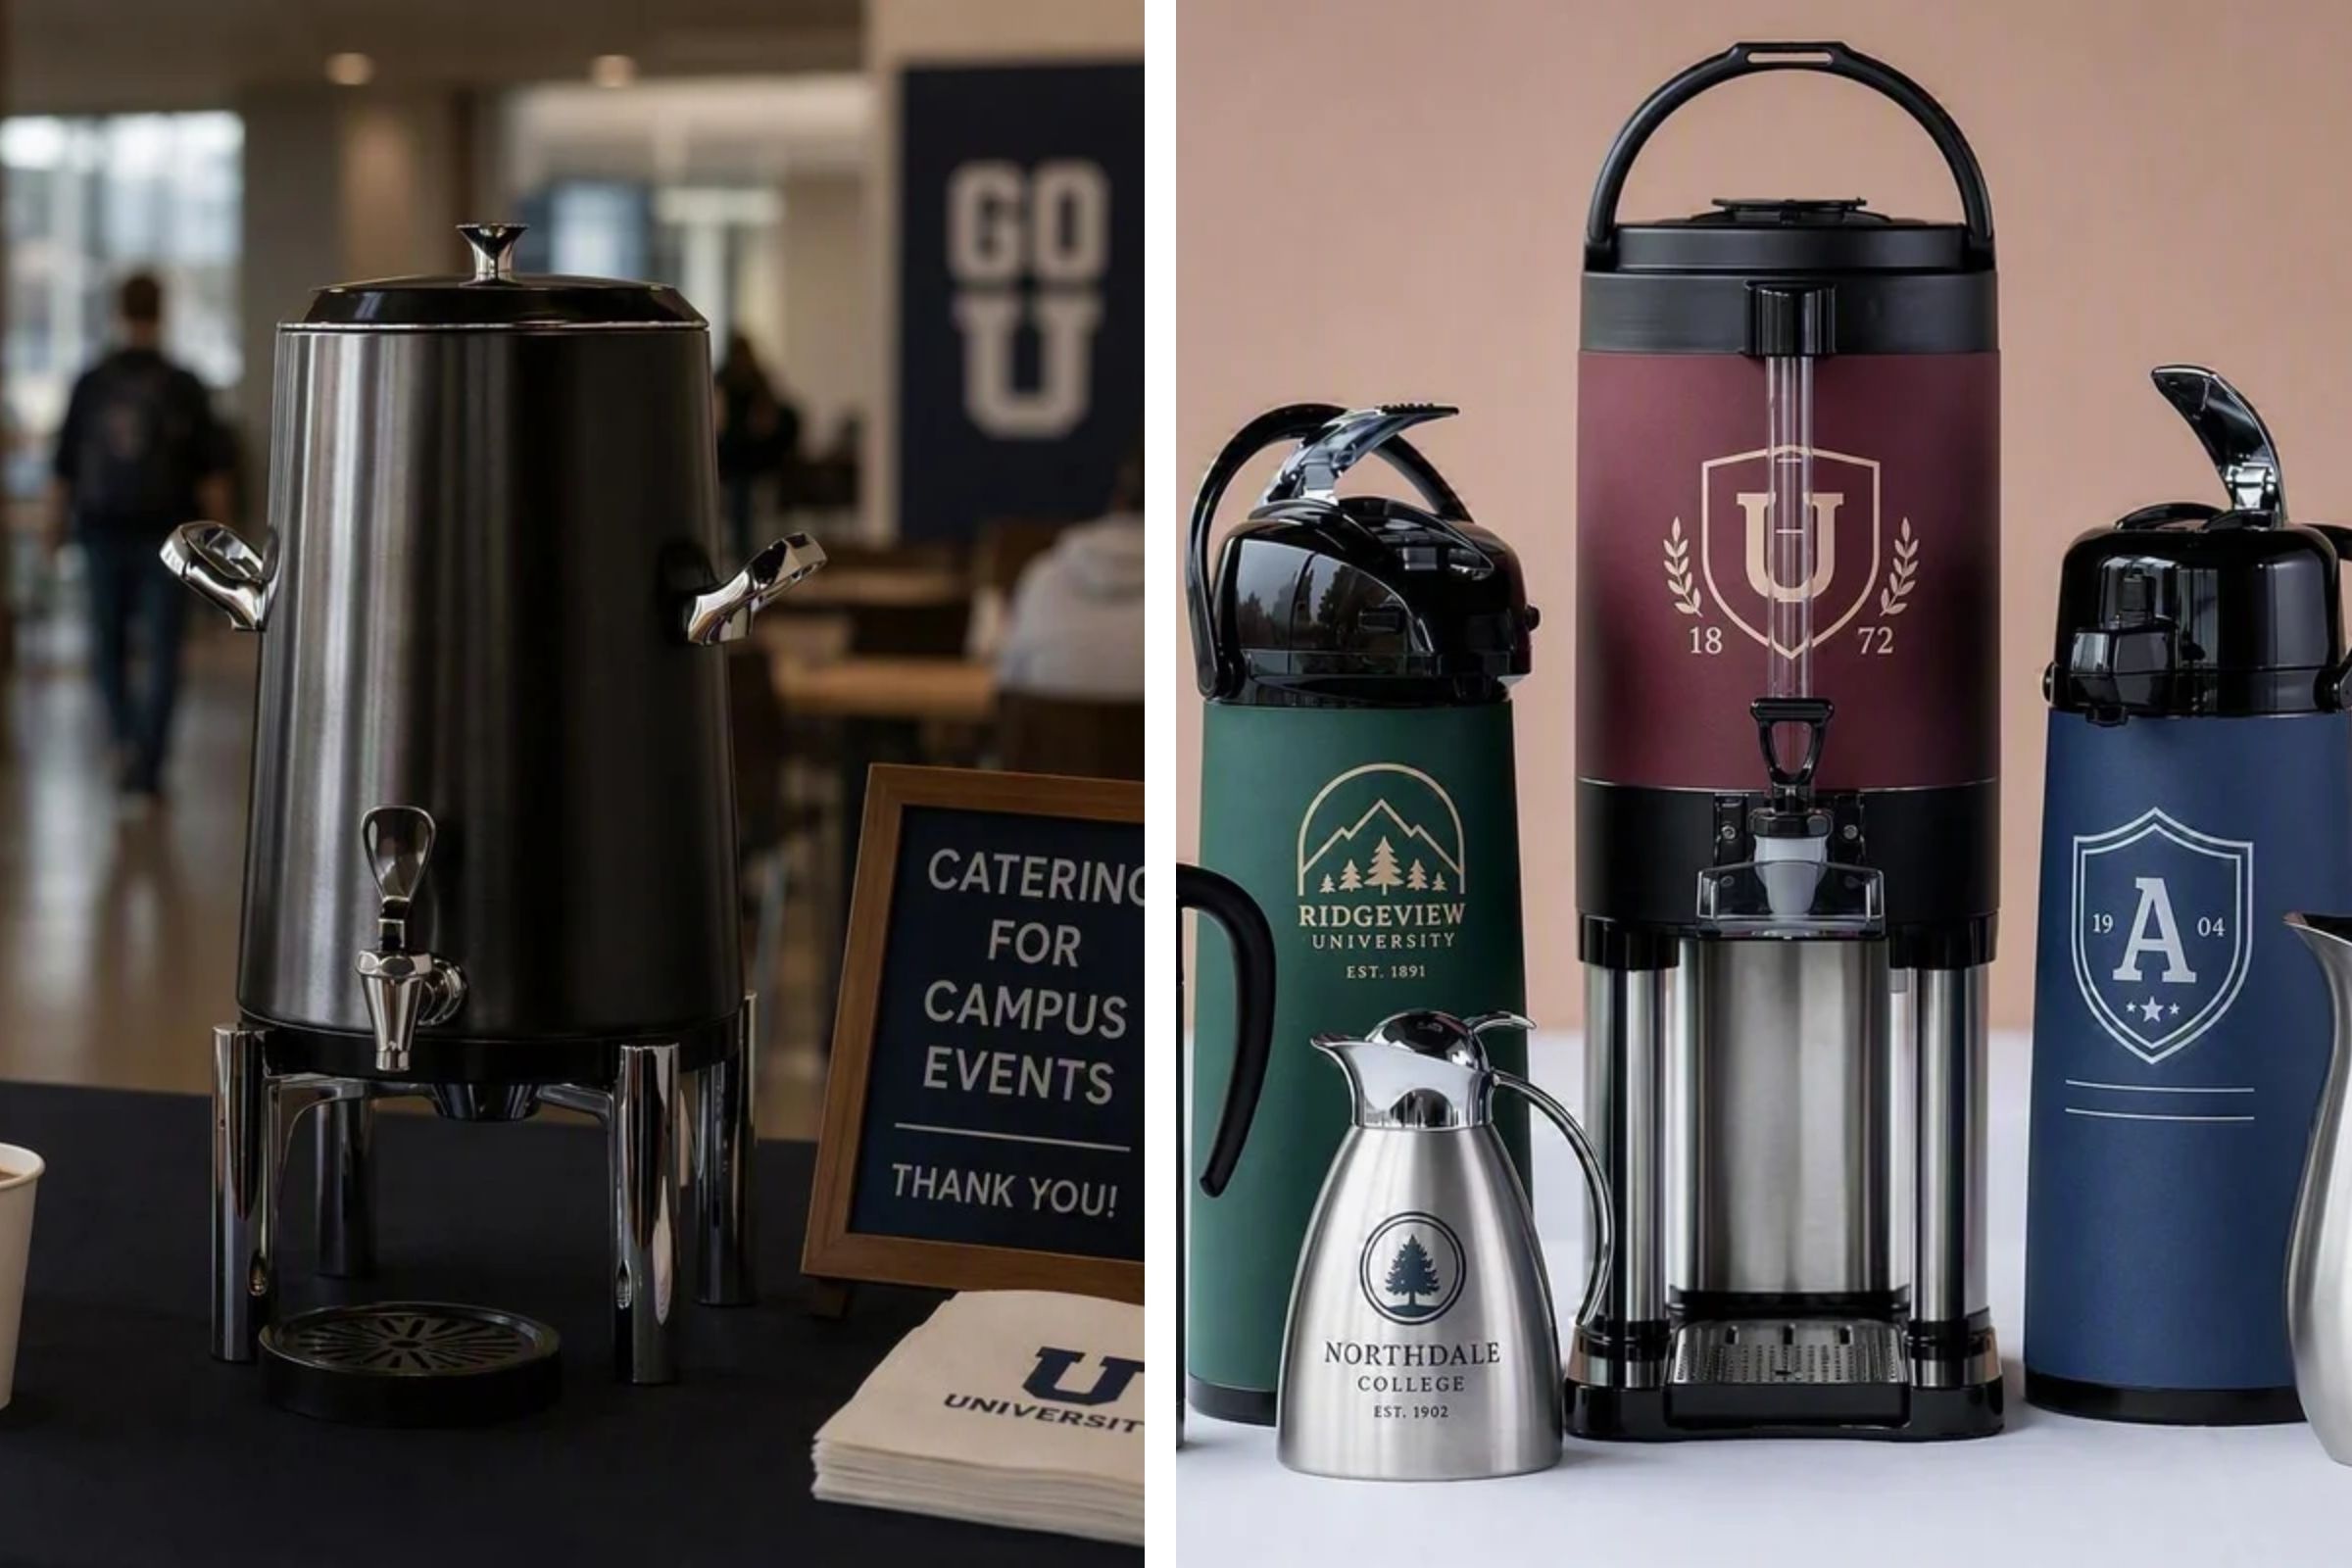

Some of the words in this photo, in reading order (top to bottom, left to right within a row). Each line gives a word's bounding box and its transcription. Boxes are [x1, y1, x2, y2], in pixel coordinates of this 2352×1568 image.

[947, 160, 1111, 280] GO
[953, 292, 1103, 438] U
[1737, 493, 1843, 602] U
[1690, 626, 1722, 654] 18
[1858, 626, 1893, 654] 72
[1298, 903, 1466, 928] RIDGEVIEW
[2092, 913, 2114, 934] 19
[2197, 916, 2226, 937] 04
[2113, 877, 2196, 983] A
[988, 919, 1082, 967] FOR
[1312, 933, 1456, 950] UNIVERSITY
[1347, 965, 1385, 979] EST.
[1392, 965, 1426, 978] 1891
[924, 980, 1128, 1040] CAMPUS
[923, 1046, 1115, 1105] EVENTS
[893, 1163, 1015, 1207] THANK
[1028, 1177, 1117, 1218] YOU!
[1023, 1347, 1145, 1405] U
[1325, 1342, 1500, 1367] NORTHDALE
[1357, 1375, 1465, 1393] COLLEGE
[1373, 1405, 1406, 1418] EST.
[1414, 1405, 1448, 1418] 1902
